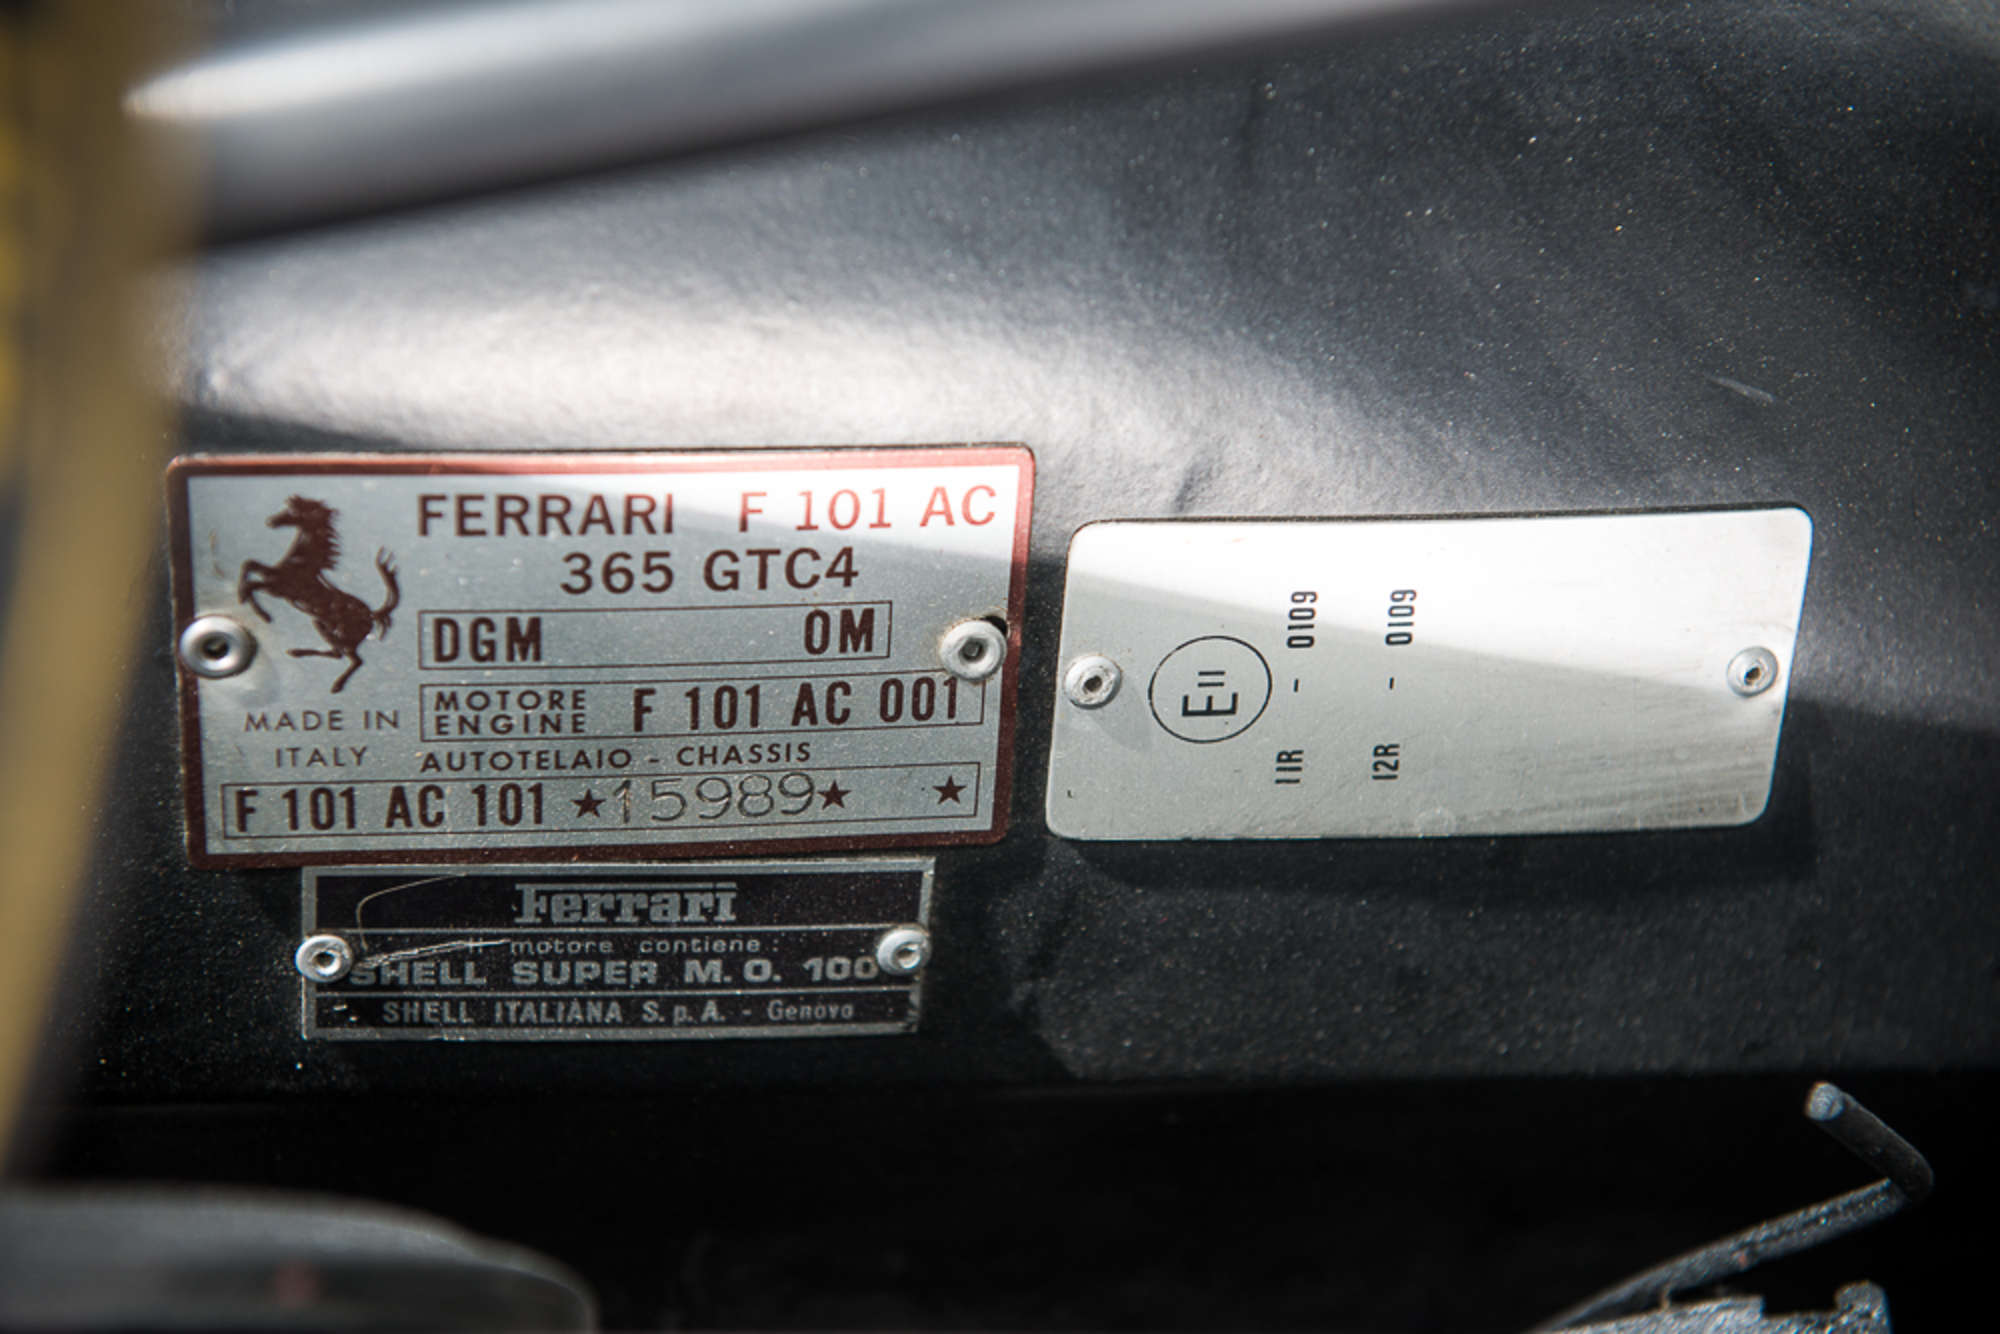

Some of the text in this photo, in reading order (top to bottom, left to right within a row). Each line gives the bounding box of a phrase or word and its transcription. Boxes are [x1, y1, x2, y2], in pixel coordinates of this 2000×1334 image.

[418, 484, 997, 537] FERRARI F 101 AC
[560, 546, 859, 594] 365 GTC4
[1286, 590, 1318, 649] 0109
[1385, 588, 1417, 646] 0109
[433, 616, 542, 662] DGM
[434, 689, 586, 712] MOTORE
[633, 676, 959, 732] F 101 AC 001
[244, 709, 399, 732] MADE IN
[434, 713, 586, 736] ENGINE
[275, 746, 368, 768] ITALY
[420, 747, 632, 773] AUTOTELAIO
[676, 742, 811, 767] CHASSIS
[1274, 749, 1304, 785] 11R
[1371, 743, 1401, 781] 12R
[234, 772, 816, 833] F 101 AC 101 15989
[514, 881, 737, 924] Ferrari
[511, 941, 613, 955] motore
[351, 961, 487, 986] SHELL
[512, 959, 658, 985] SUPER
[803, 956, 878, 982] 100
[382, 1001, 474, 1024] SHELL
[494, 1001, 623, 1024] ITALIANA
